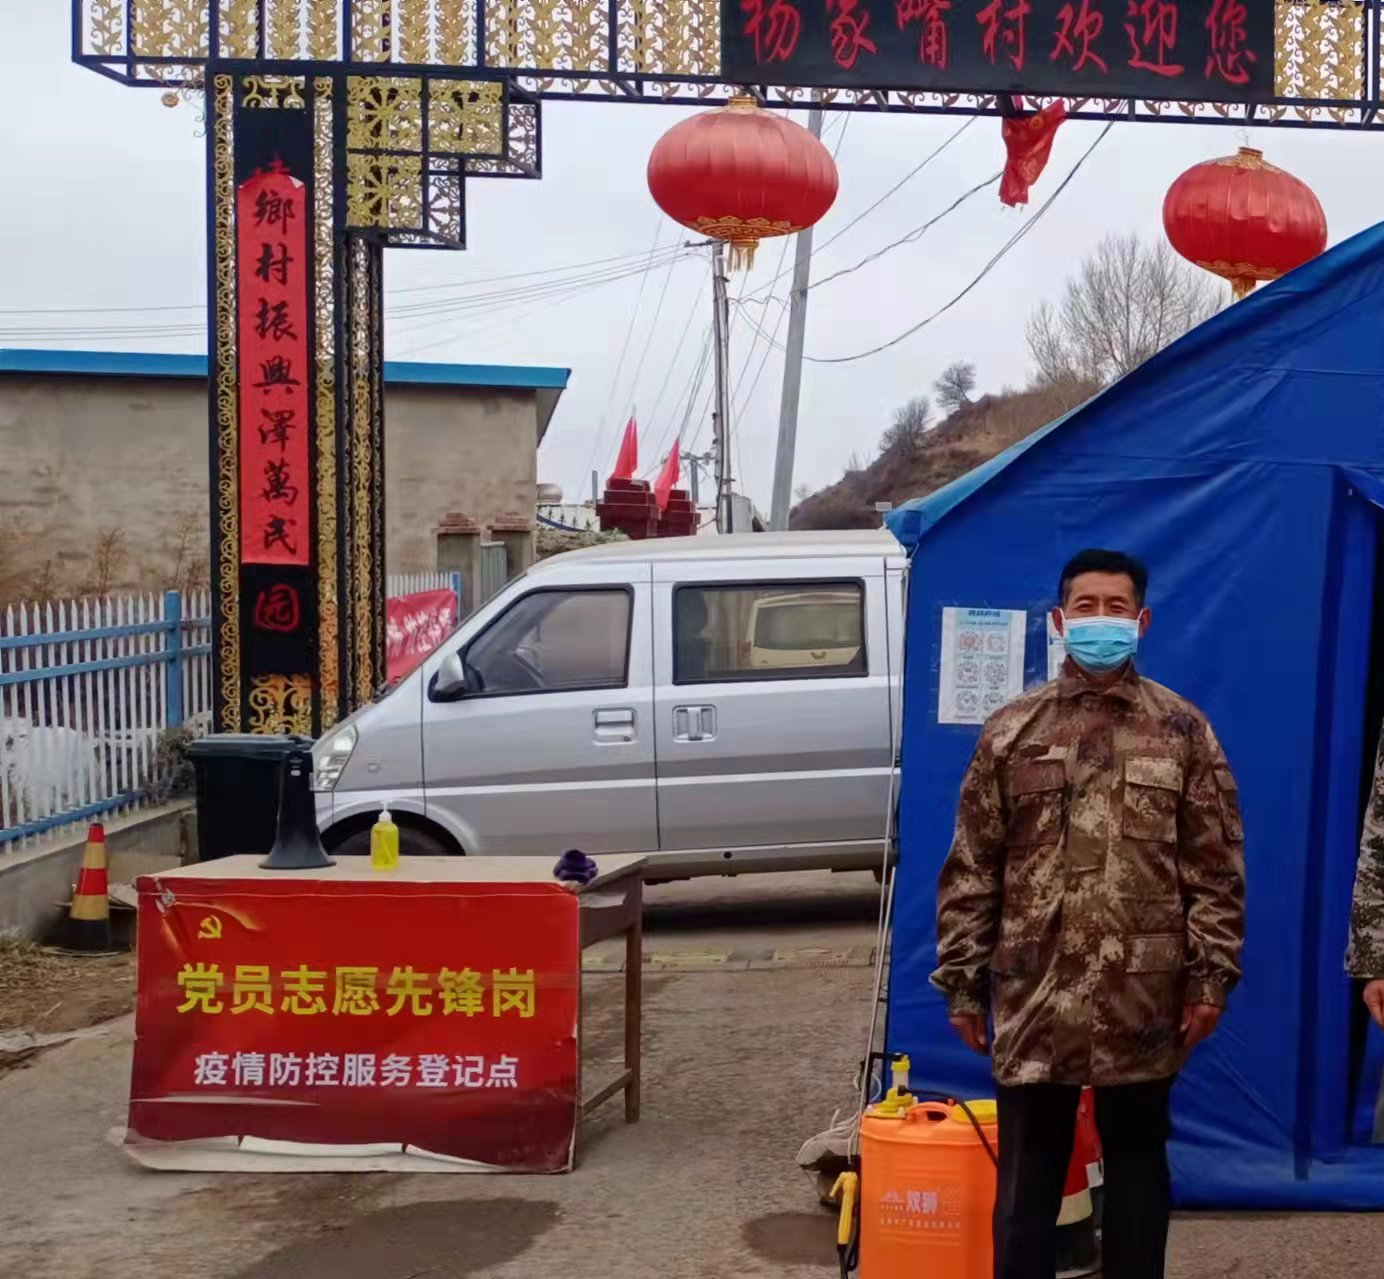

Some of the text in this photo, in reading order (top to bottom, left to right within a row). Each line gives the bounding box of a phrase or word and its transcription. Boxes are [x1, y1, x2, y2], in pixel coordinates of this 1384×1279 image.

[176, 963, 535, 1018] 党员志愿先锋岗
[193, 1051, 519, 1088] 疫情防控服务登记点
